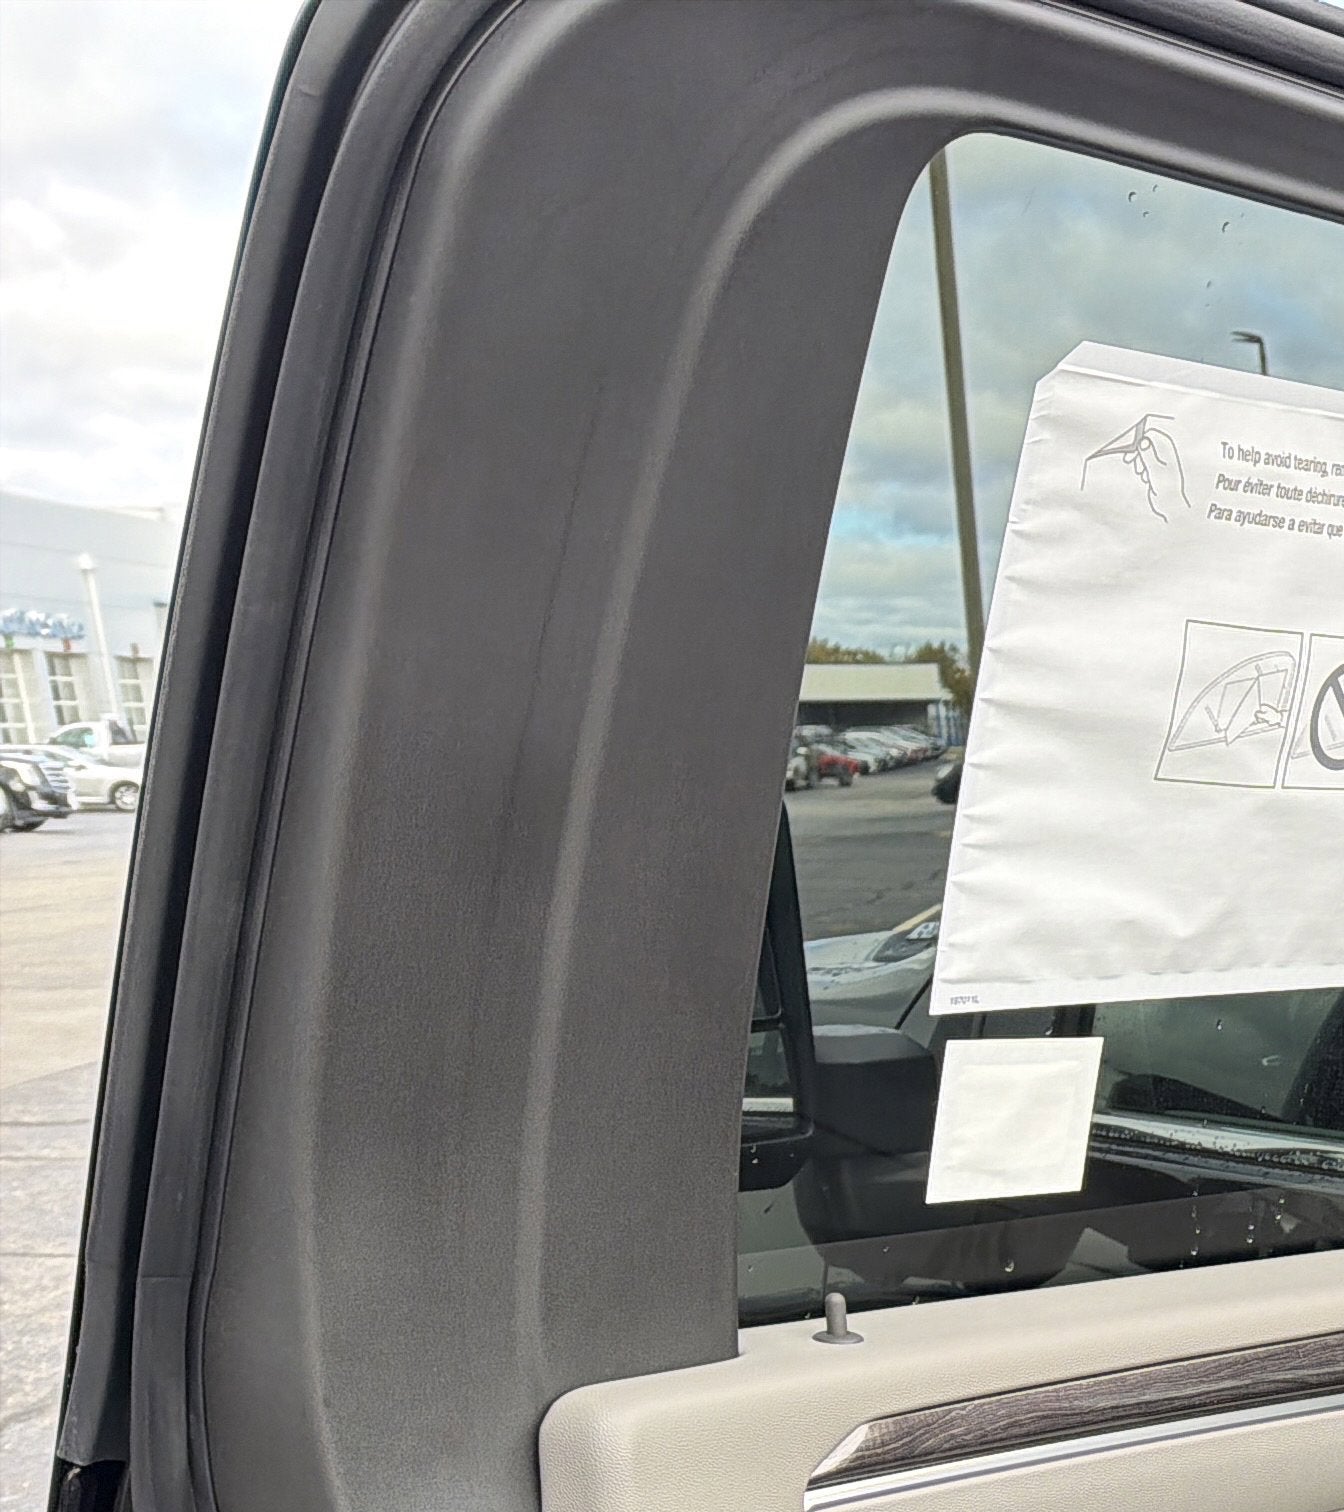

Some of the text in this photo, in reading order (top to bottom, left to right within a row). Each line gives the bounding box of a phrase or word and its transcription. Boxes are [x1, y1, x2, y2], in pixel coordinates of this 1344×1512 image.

[1221, 442, 1234, 460] To
[1238, 444, 1261, 467] help
[1264, 452, 1291, 469] avoid
[1215, 474, 1242, 491] Pour
[1243, 477, 1274, 496] éviter
[1276, 483, 1304, 501] toute
[1207, 503, 1233, 521] Para
[1234, 509, 1286, 529] ayudarse
[1288, 518, 1295, 531] a
[1298, 518, 1325, 535] evitar
[1327, 523, 1343, 539] que
